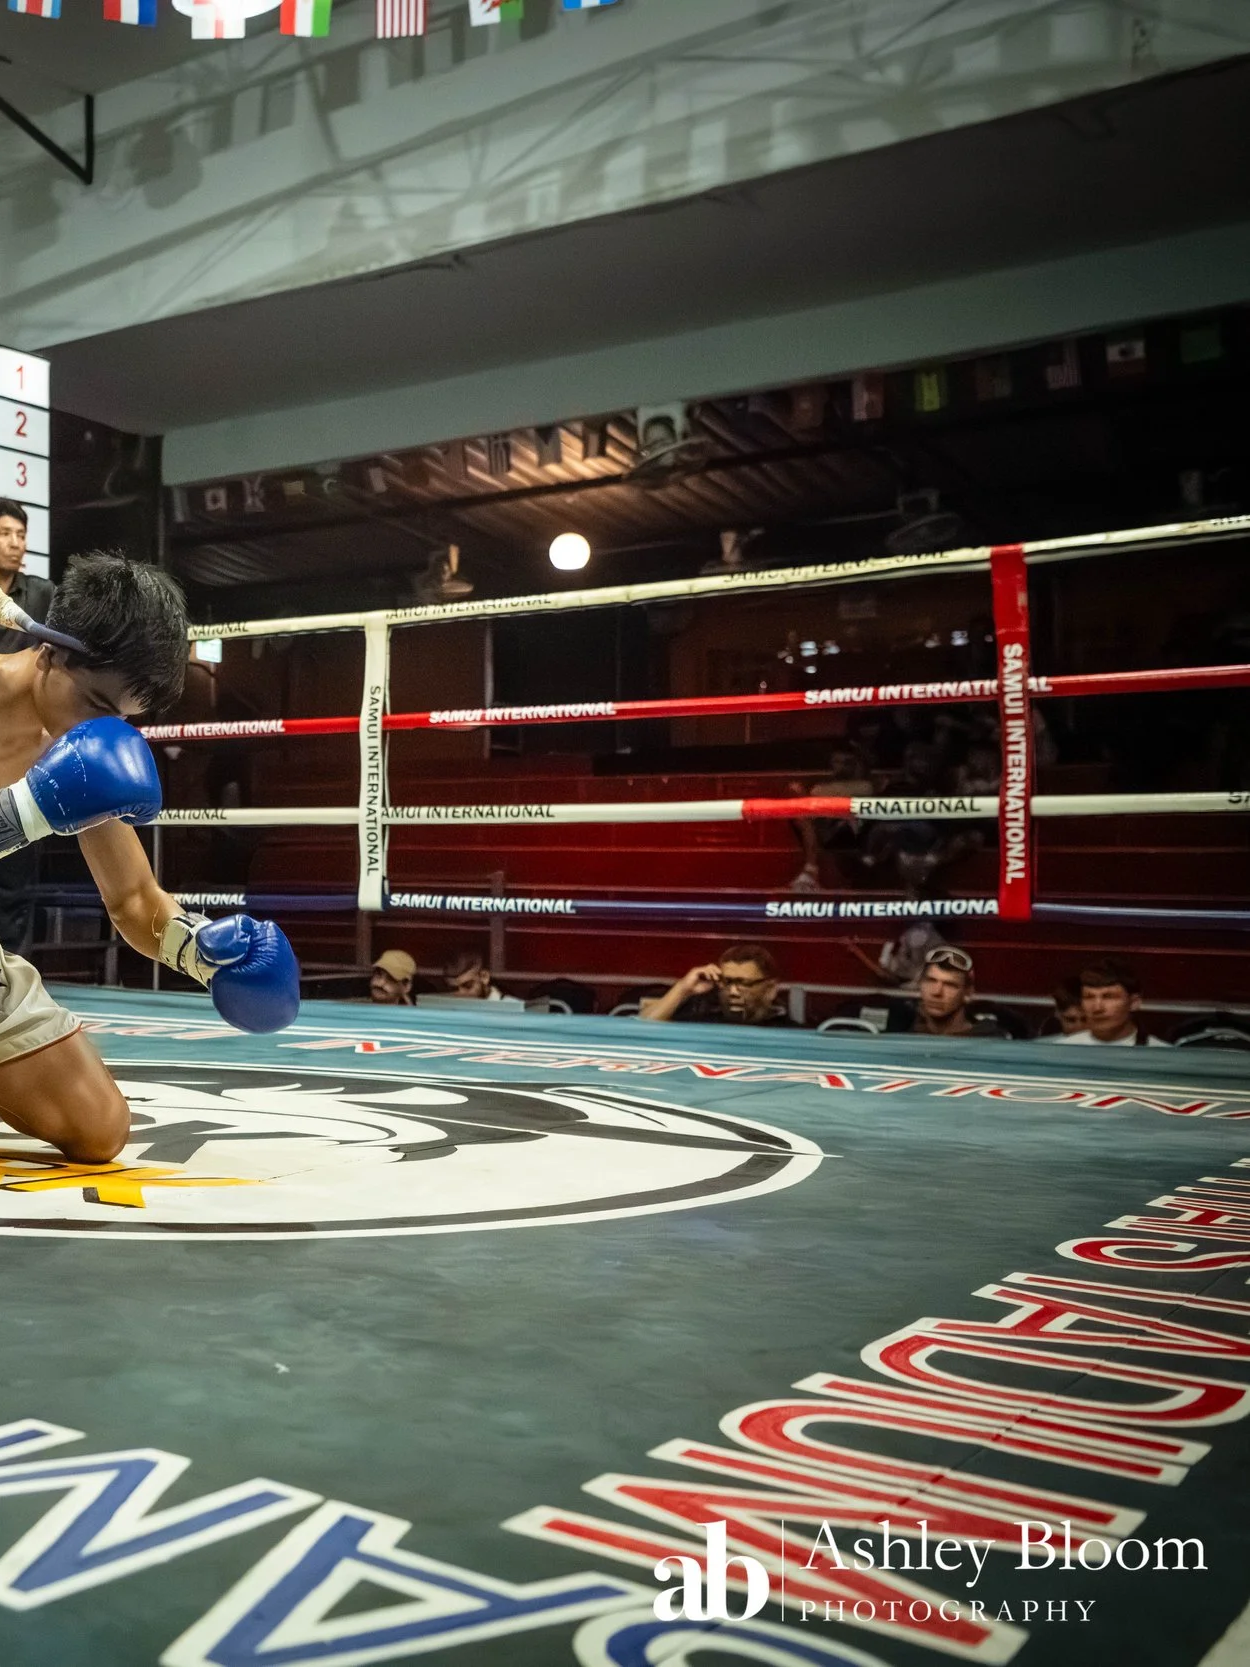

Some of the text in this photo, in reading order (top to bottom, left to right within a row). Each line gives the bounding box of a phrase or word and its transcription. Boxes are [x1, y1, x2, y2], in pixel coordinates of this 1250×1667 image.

[16, 365, 24, 390] 1
[15, 411, 28, 438] 2
[16, 462, 28, 487] 3
[190, 622, 249, 637] NATIONAL
[804, 686, 874, 705] SAMUI
[429, 701, 617, 724] SAMUI INTERNATIONAL
[139, 719, 285, 739] SAMUI INTERNATIONAL
[1002, 642, 1027, 885] SAMUI INTERNATIONAL
[365, 685, 381, 877] SAMUI INTERNATIONAL
[381, 803, 556, 820] AMUI INTERNATIONAL
[389, 893, 577, 915] SAMUI INTERNATIONAL
[765, 898, 999, 918] SAMUI INTERNATIONA
[277, 1037, 1250, 1120] INTERNATION
